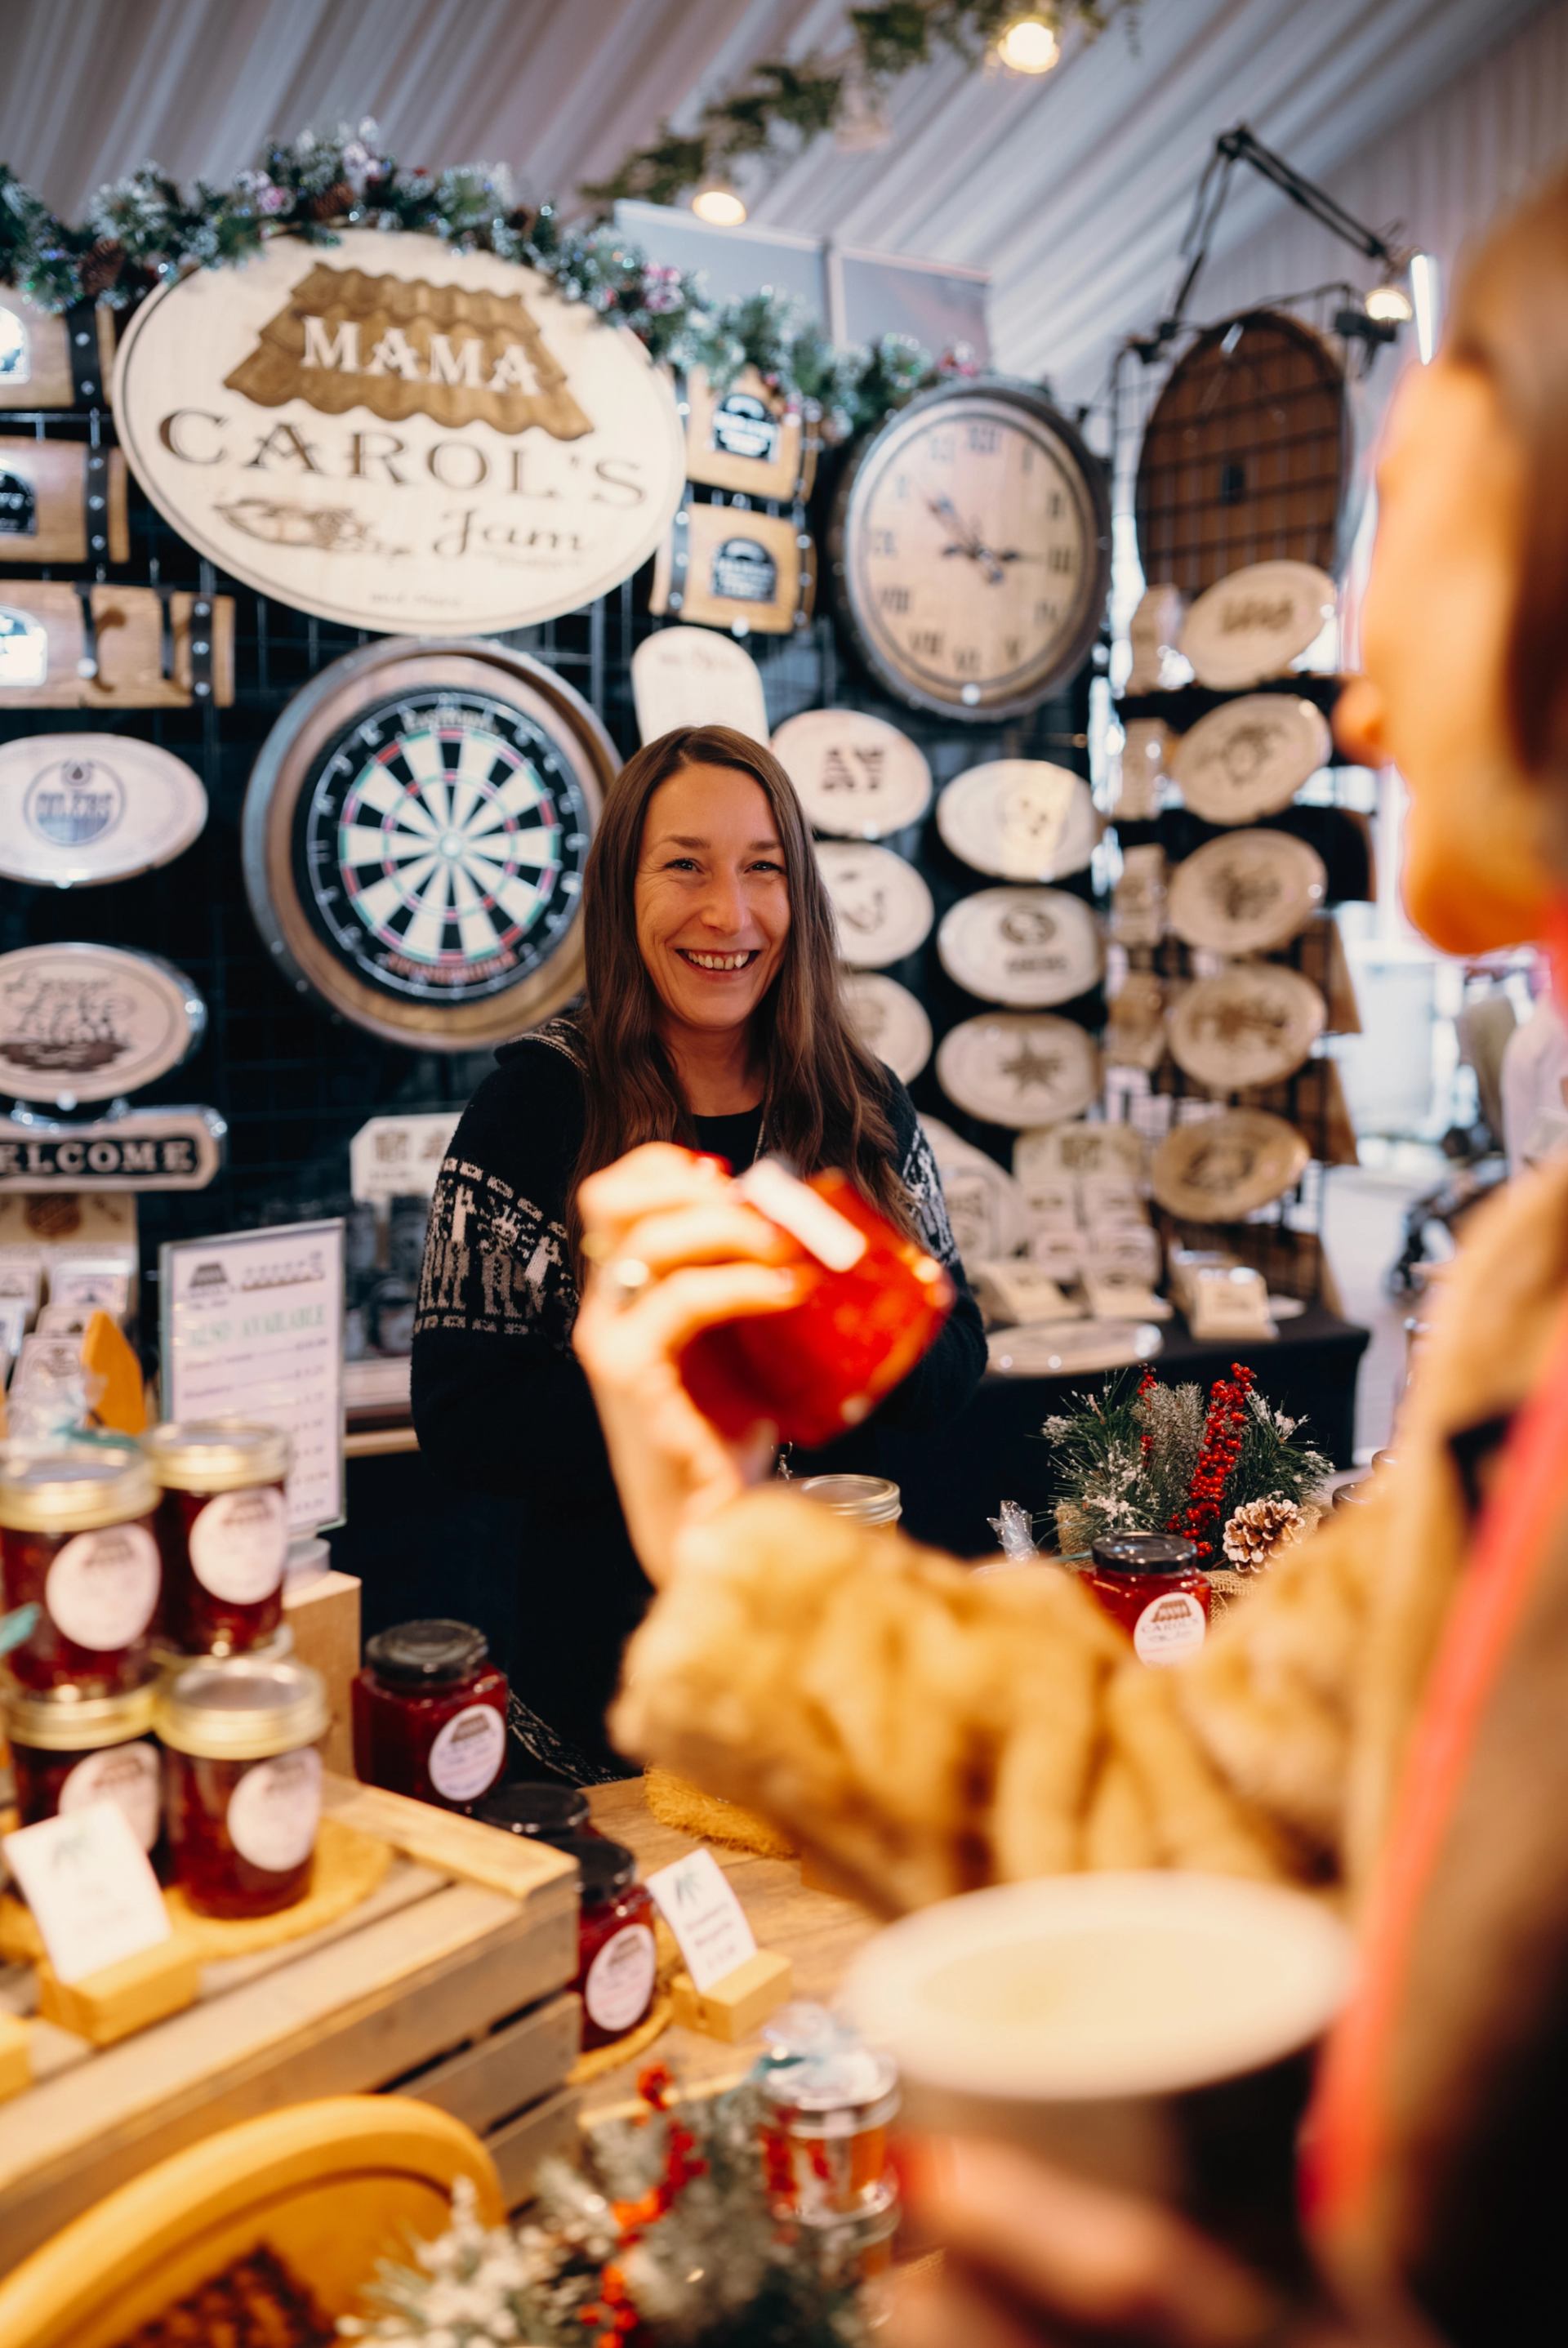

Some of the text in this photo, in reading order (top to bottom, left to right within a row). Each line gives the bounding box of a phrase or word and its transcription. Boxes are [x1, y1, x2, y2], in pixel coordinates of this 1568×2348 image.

[301, 315, 542, 396] MAMA
[158, 408, 648, 509] CAROL'S
[433, 506, 585, 557] Jam
[0, 1141, 197, 1174] ELCOME
